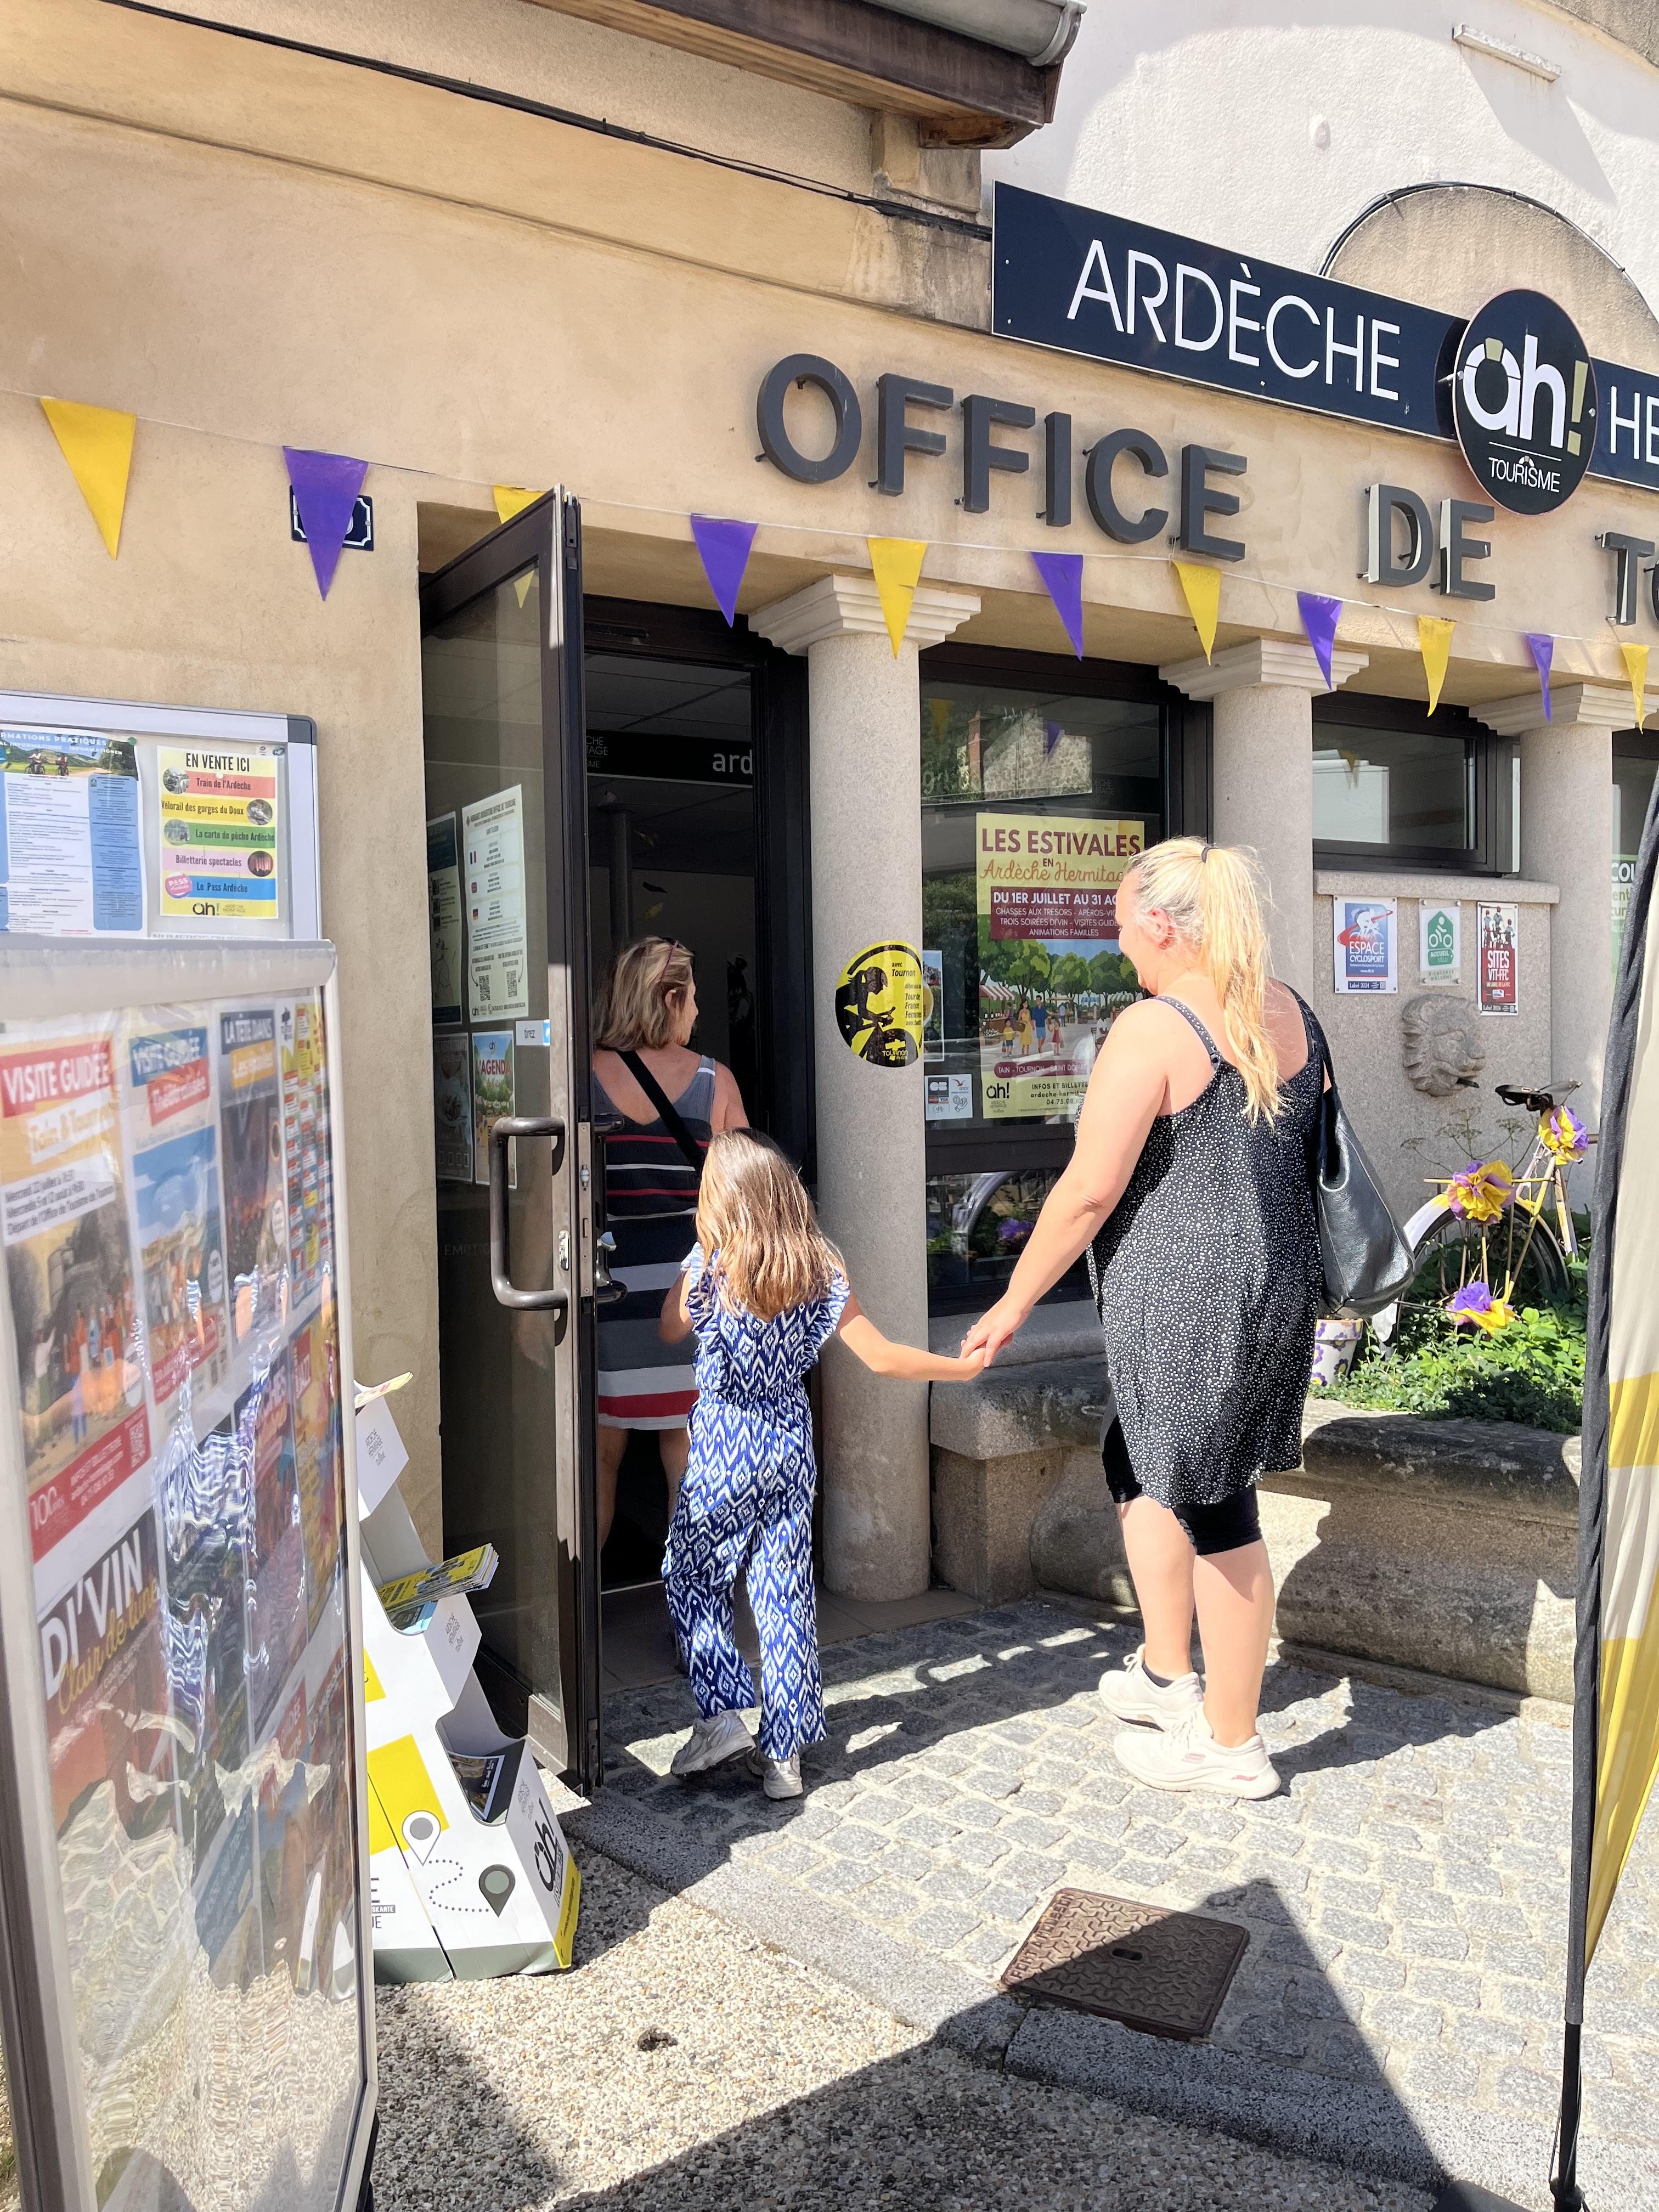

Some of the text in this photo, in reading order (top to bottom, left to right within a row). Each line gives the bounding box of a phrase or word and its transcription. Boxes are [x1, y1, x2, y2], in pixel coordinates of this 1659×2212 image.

[1066, 239, 1401, 401] ARDÈCHE
[1463, 334, 1589, 456] ah!
[1488, 455, 1561, 493] TOURISME
[757, 353, 1659, 626] OFFICE DE T
[55, 736, 106, 746] PRATIQUES
[186, 752, 250, 772] EN VENTE ICI
[713, 748, 753, 775] ard
[196, 777, 212, 787] Train
[214, 780, 221, 788] de
[161, 799, 244, 815] Vélorail des gorges du Doux
[196, 829, 203, 838] La
[204, 830, 220, 839] carte
[222, 831, 230, 840] de
[231, 831, 249, 841] pêche
[982, 828, 1141, 857] LES ESTIVALES
[176, 855, 242, 867] Billetterie spectacles
[1042, 858, 1054, 867] EN
[979, 859, 1051, 880] Ardèche
[168, 877, 188, 887] PASS
[197, 882, 248, 893] Le Pass Ardèche
[994, 891, 1009, 903] DU
[1012, 892, 1029, 904] 1ER
[1031, 893, 1071, 905] JUILLET
[1073, 894, 1089, 905] AU
[1091, 894, 1102, 905] 31
[1043, 907, 1073, 916] TRÉSORS
[1020, 917, 1049, 926] SOIRÉES
[1074, 918, 1097, 927] VISITES
[1349, 941, 1385, 955] ESPACE
[1487, 950, 1510, 969] SITES
[891, 968, 916, 977] Tournon
[1488, 968, 1509, 981] VTT-FFC
[905, 992, 916, 1001] Tour
[905, 1002, 919, 1010] France
[524, 1028, 535, 1039] tirez
[2, 1044, 109, 1105] VISITE GUIDÉE
[475, 1058, 511, 1075] L'AGENDA
[986, 1082, 1009, 1099] ah!
[31, 1217, 39, 1227] de
[59, 1204, 66, 1215] de
[66, 1198, 89, 1211] Tourisme
[41, 1528, 144, 1701] DI'VIN
[59, 1646, 105, 1716] Clair
[106, 1608, 126, 1660] de
[1010, 1949, 1037, 1979] PONT
